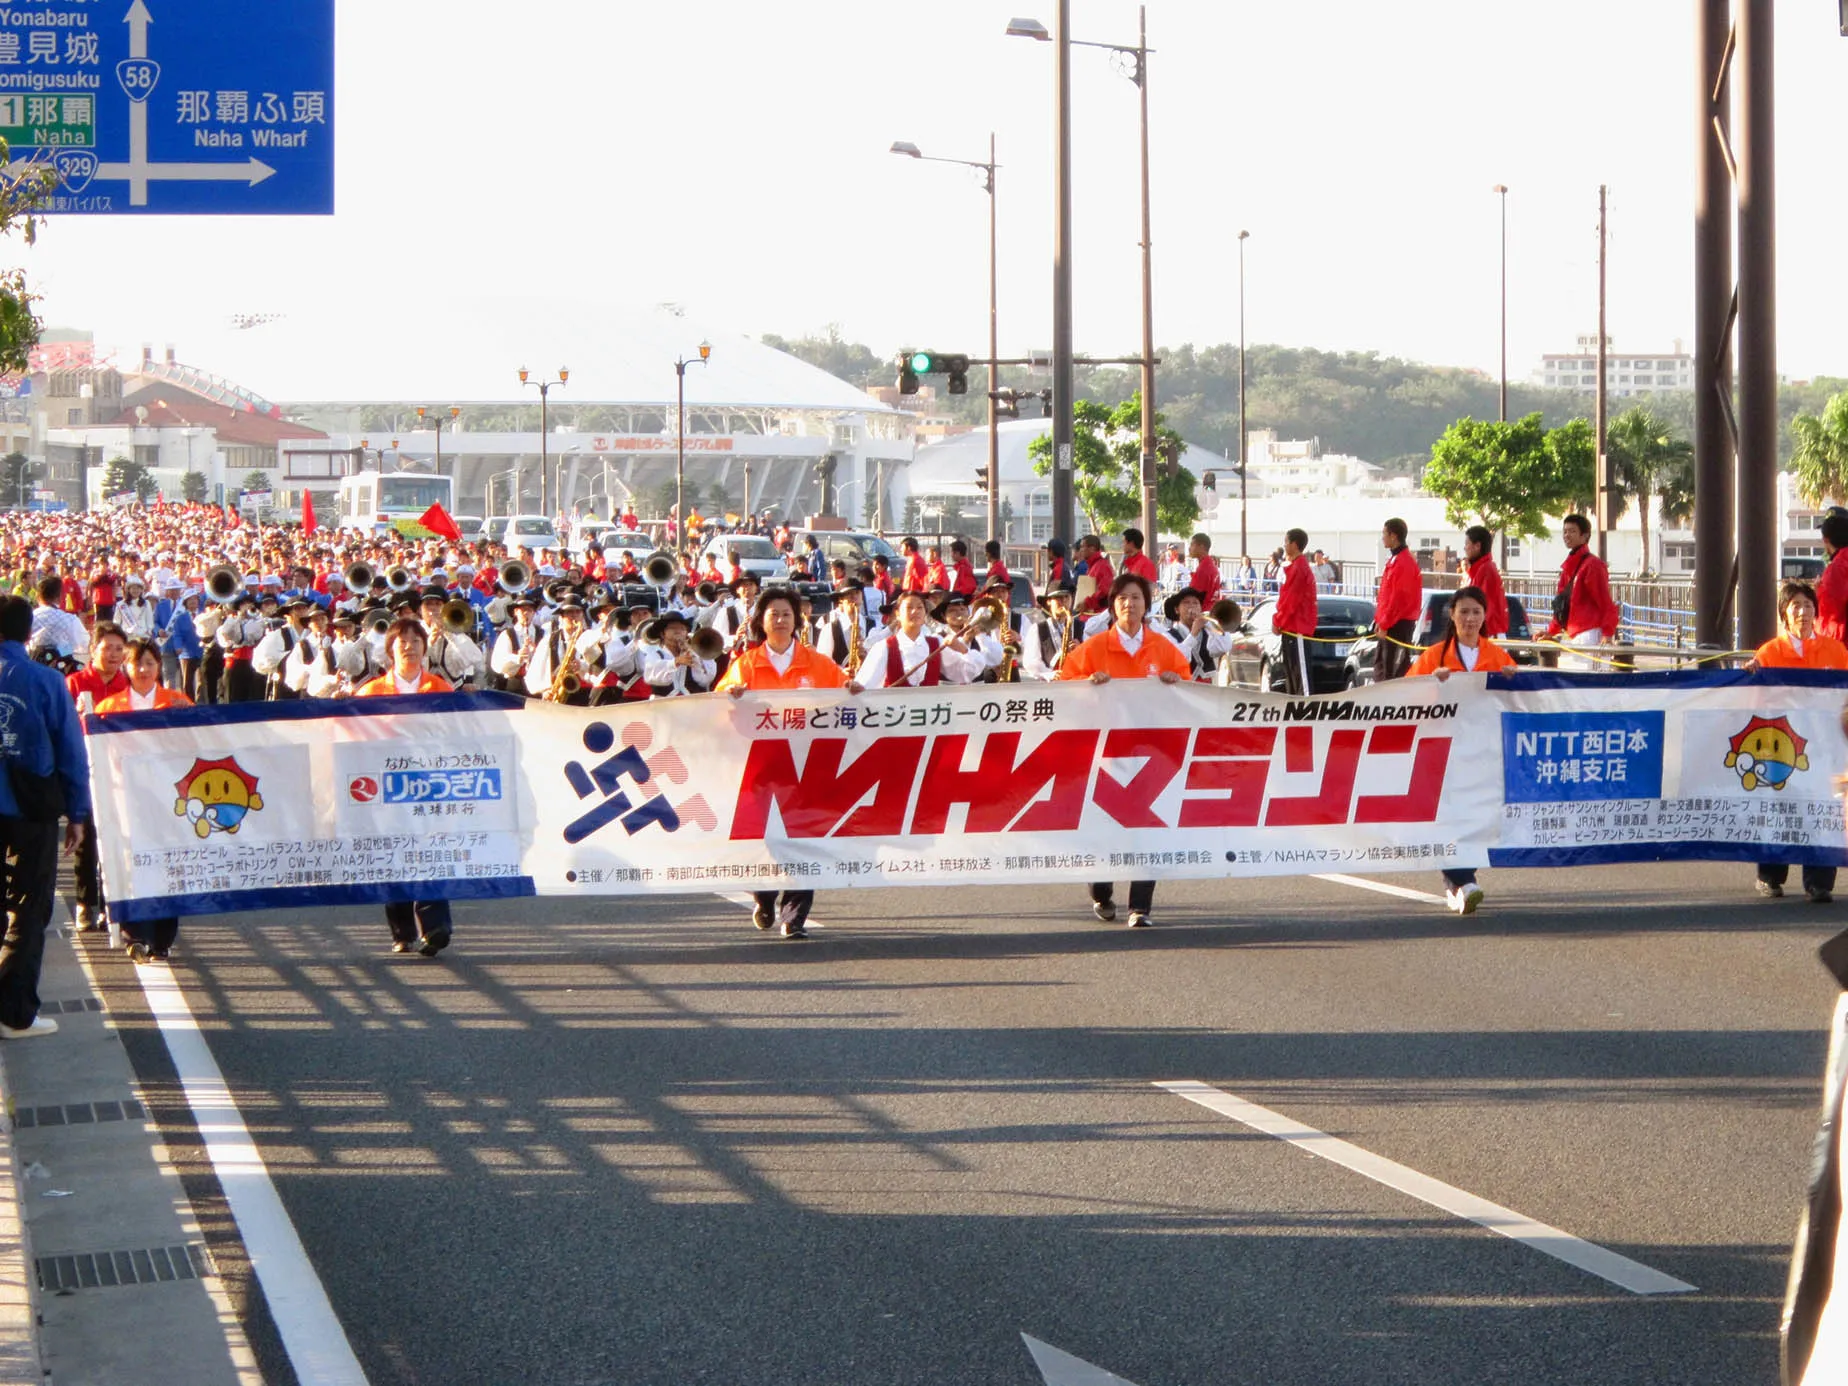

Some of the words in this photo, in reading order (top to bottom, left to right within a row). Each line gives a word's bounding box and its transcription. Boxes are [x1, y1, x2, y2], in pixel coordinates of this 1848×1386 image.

[0, 8, 88, 26] Yonabaru
[125, 67, 151, 87] 58
[28, 97, 91, 125] 那覇
[176, 91, 325, 124] 那覇ふ頭
[34, 129, 85, 144] Naha
[195, 129, 243, 147] Naha
[252, 129, 307, 147] Wharf
[60, 158, 91, 177] 329
[755, 698, 1055, 730] 太陽と海とジョガーの祭典
[1232, 702, 1280, 722] 27th
[1283, 701, 1355, 721] NAHA
[1353, 702, 1459, 721] MARATHON
[1516, 730, 1648, 757] NTT西日本
[730, 725, 1453, 840] NAHAマラソン
[1536, 758, 1627, 784] 沖縄支店
[386, 772, 499, 800] りゅうぎん
[1576, 816, 1605, 828] JR九州
